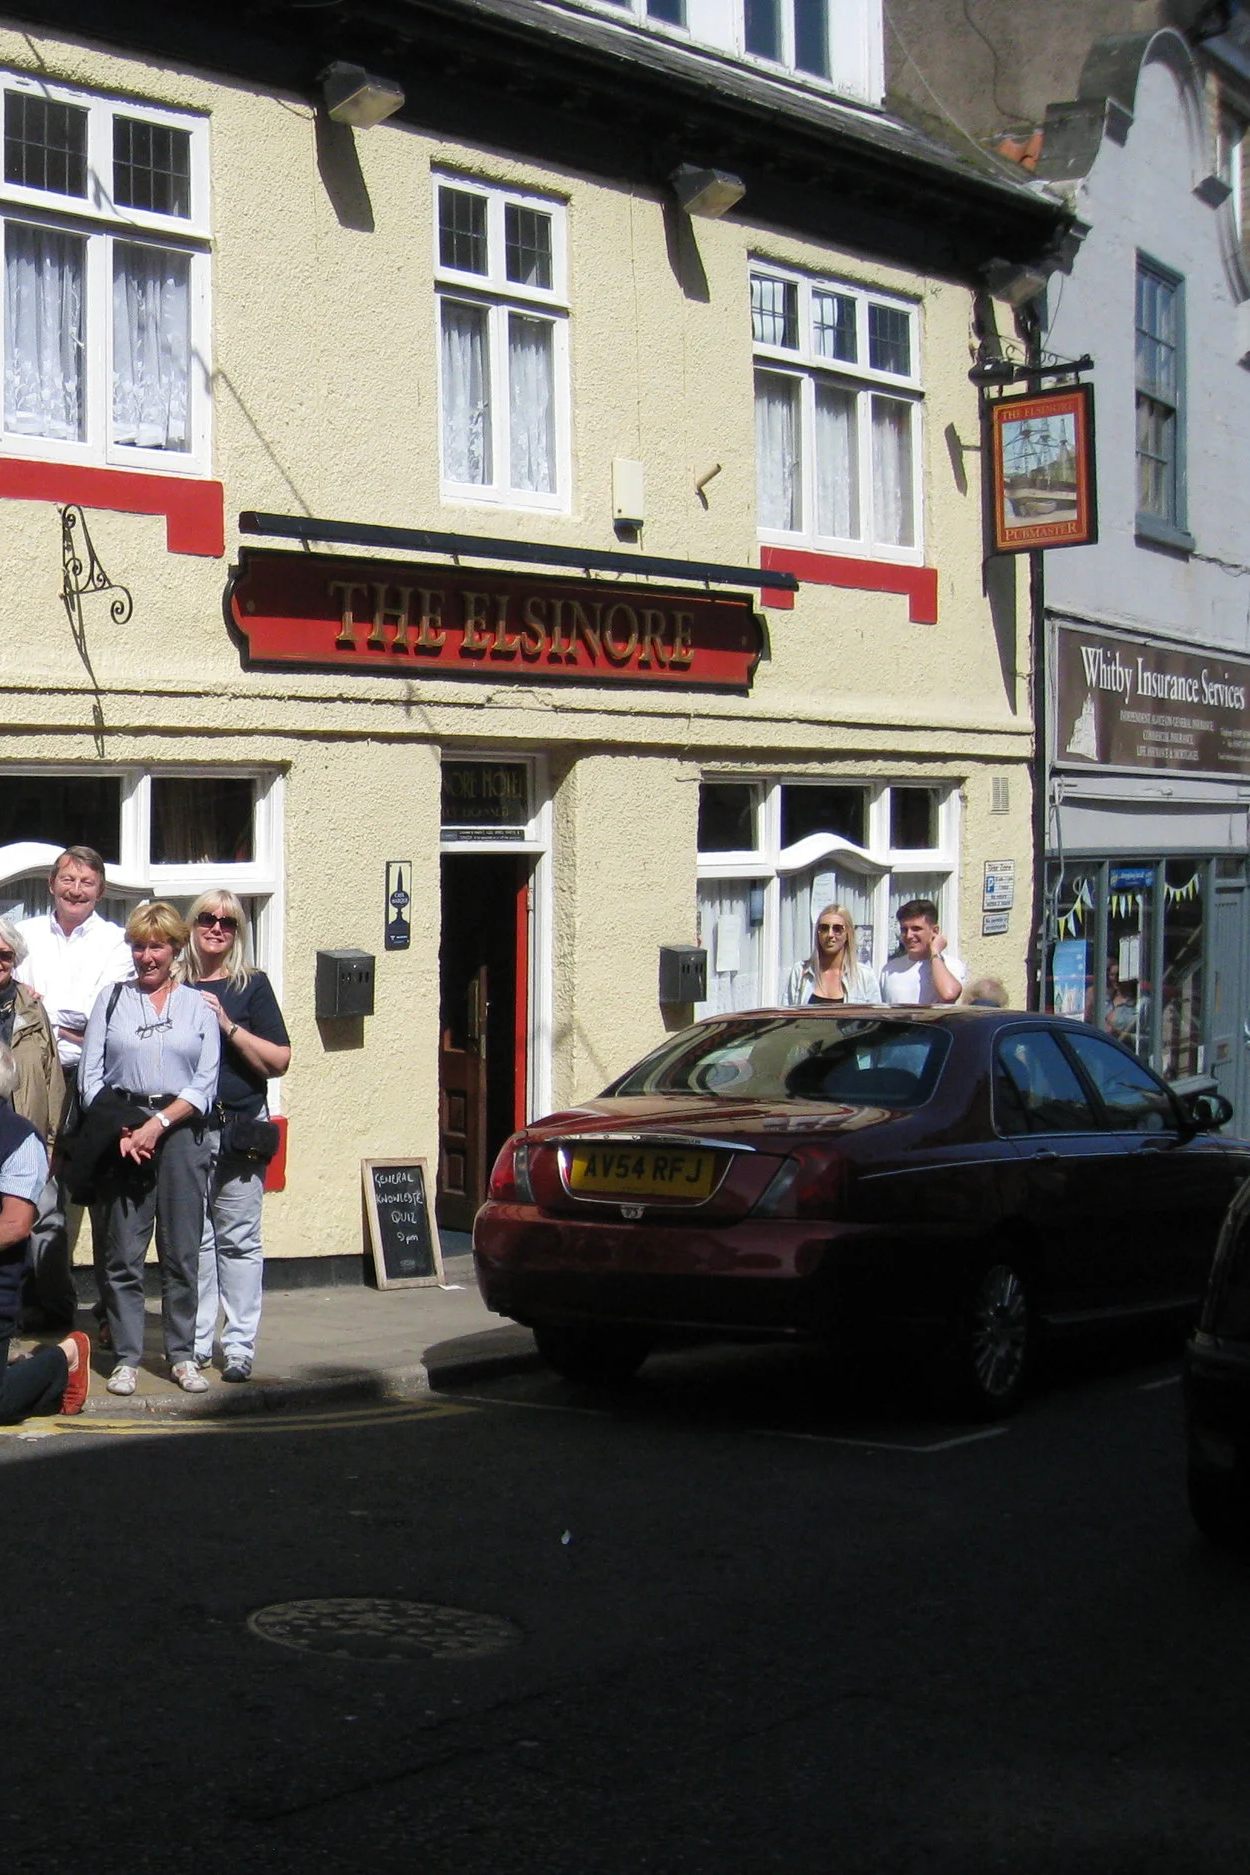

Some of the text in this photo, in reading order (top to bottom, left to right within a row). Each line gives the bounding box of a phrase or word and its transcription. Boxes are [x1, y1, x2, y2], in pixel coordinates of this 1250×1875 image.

[1005, 522, 1078, 541] PUBMASTER
[329, 580, 696, 665] THE ELSINORE
[1080, 646, 1245, 710] Whitby Insurance Services
[375, 1172, 414, 1188] GENERAL
[583, 1154, 703, 1184] AV54 RFJ
[391, 1210, 417, 1224] QUIZ
